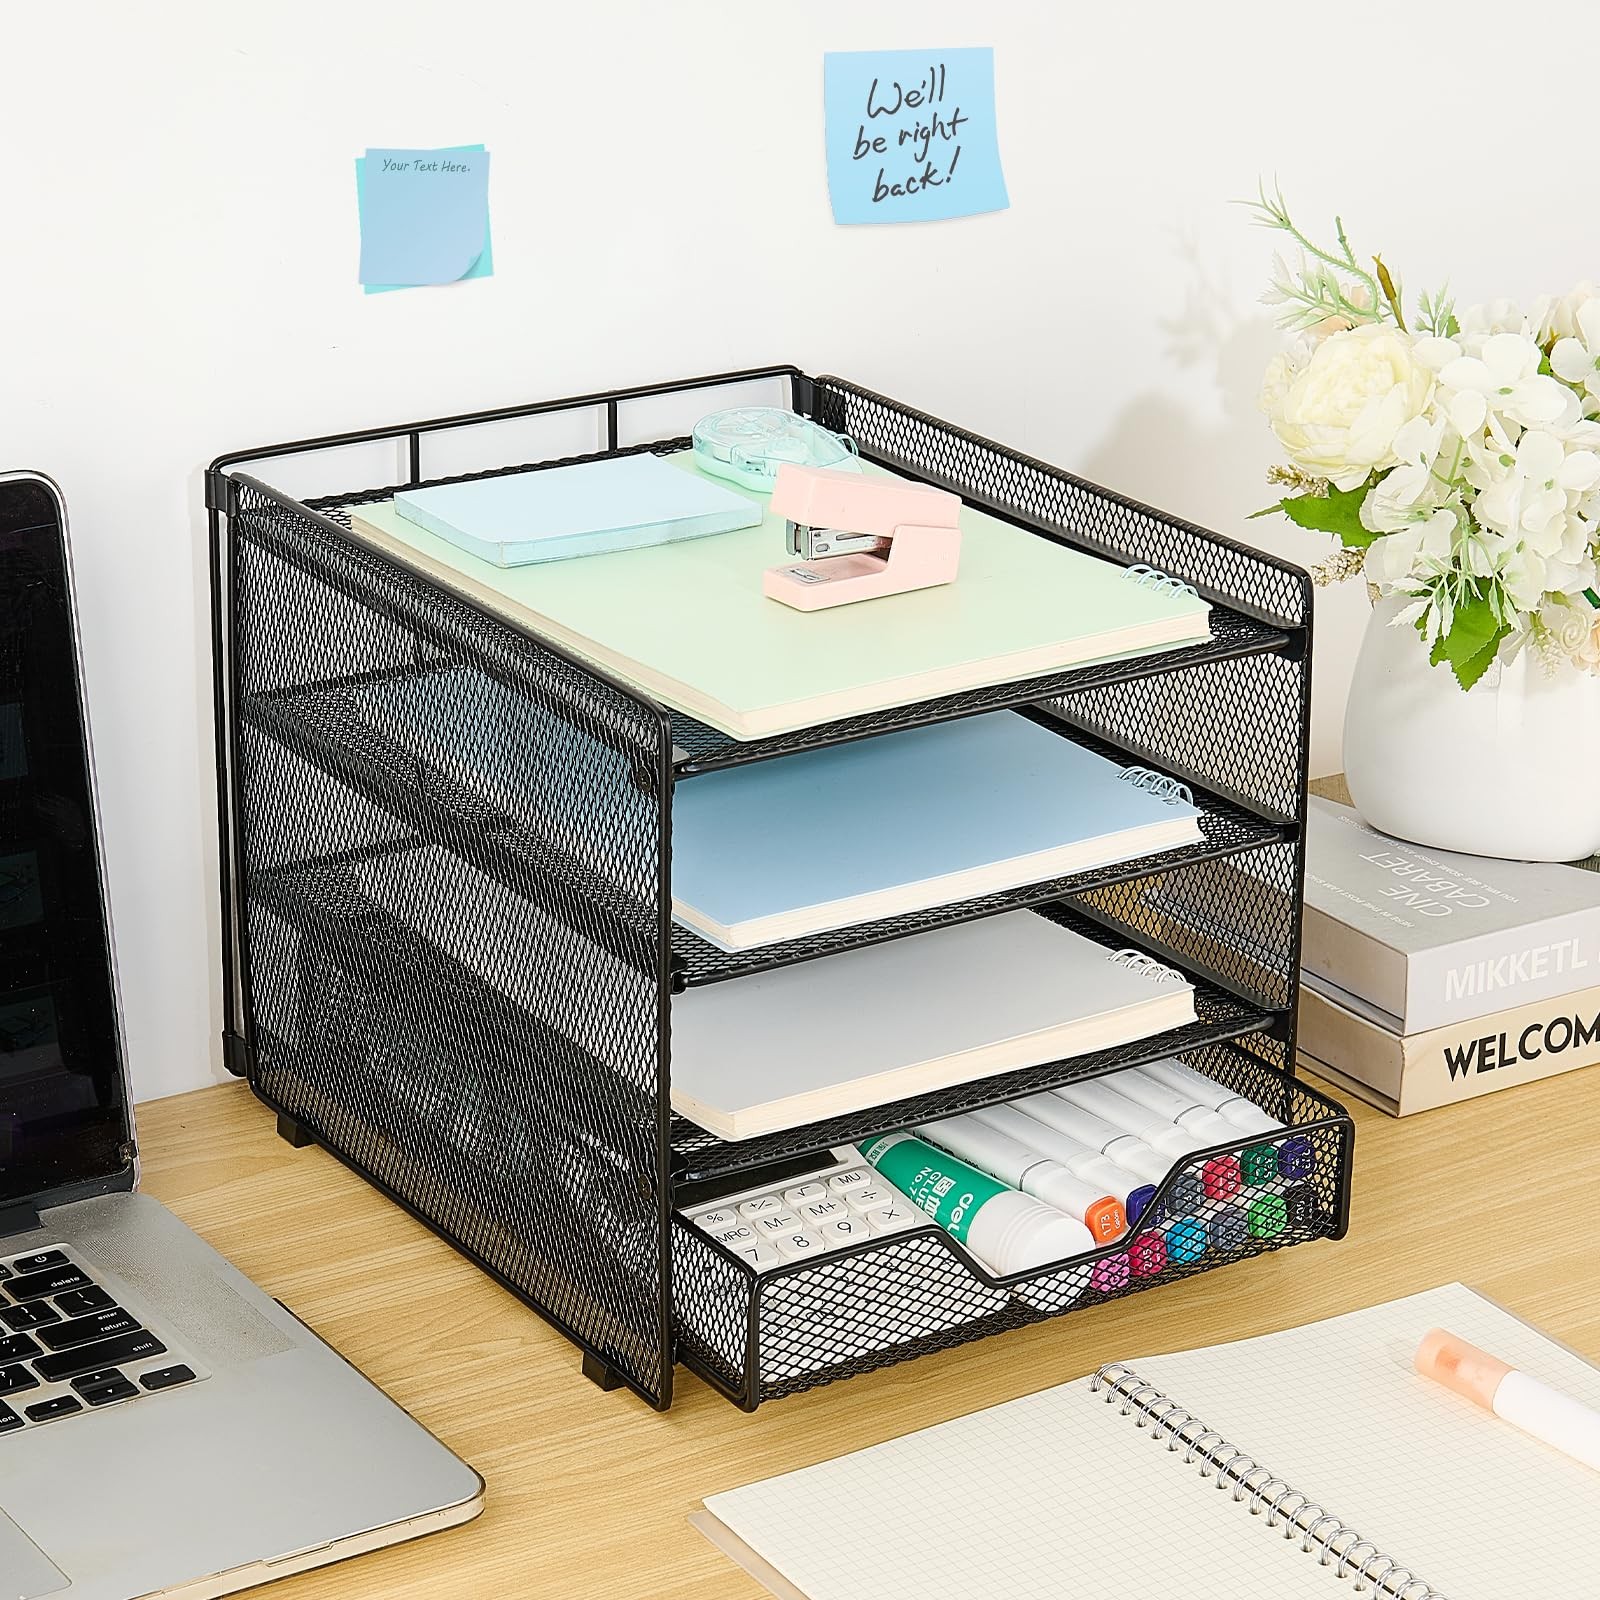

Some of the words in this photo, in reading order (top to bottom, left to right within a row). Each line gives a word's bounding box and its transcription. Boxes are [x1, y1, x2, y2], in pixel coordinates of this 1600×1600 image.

[867, 63, 946, 119] We'll
[852, 124, 888, 161] be
[898, 107, 969, 163] right
[382, 158, 410, 172] Your
[414, 159, 438, 172] Text
[441, 160, 471, 173] Here.
[872, 145, 961, 203] back!
[1358, 852, 1491, 908] CABARET
[1379, 885, 1452, 918] CINE
[1445, 937, 1588, 1002] MIKKETL
[1444, 1012, 1600, 1082] WELCOM
[837, 1172, 861, 1185] MU
[909, 1167, 933, 1201] No.7
[916, 1172, 942, 1208] GLUE
[715, 1227, 751, 1243] MRC
[808, 1202, 837, 1216] M+
[947, 1193, 974, 1232] del
[1101, 1214, 1112, 1236] 173
[744, 1248, 759, 1262] 7
[792, 1235, 810, 1248] 8
[836, 1221, 852, 1234] 9
[50, 1276, 80, 1288] delete
[97, 1311, 118, 1320] enter
[100, 1320, 129, 1332] return
[132, 1341, 153, 1352] shift
